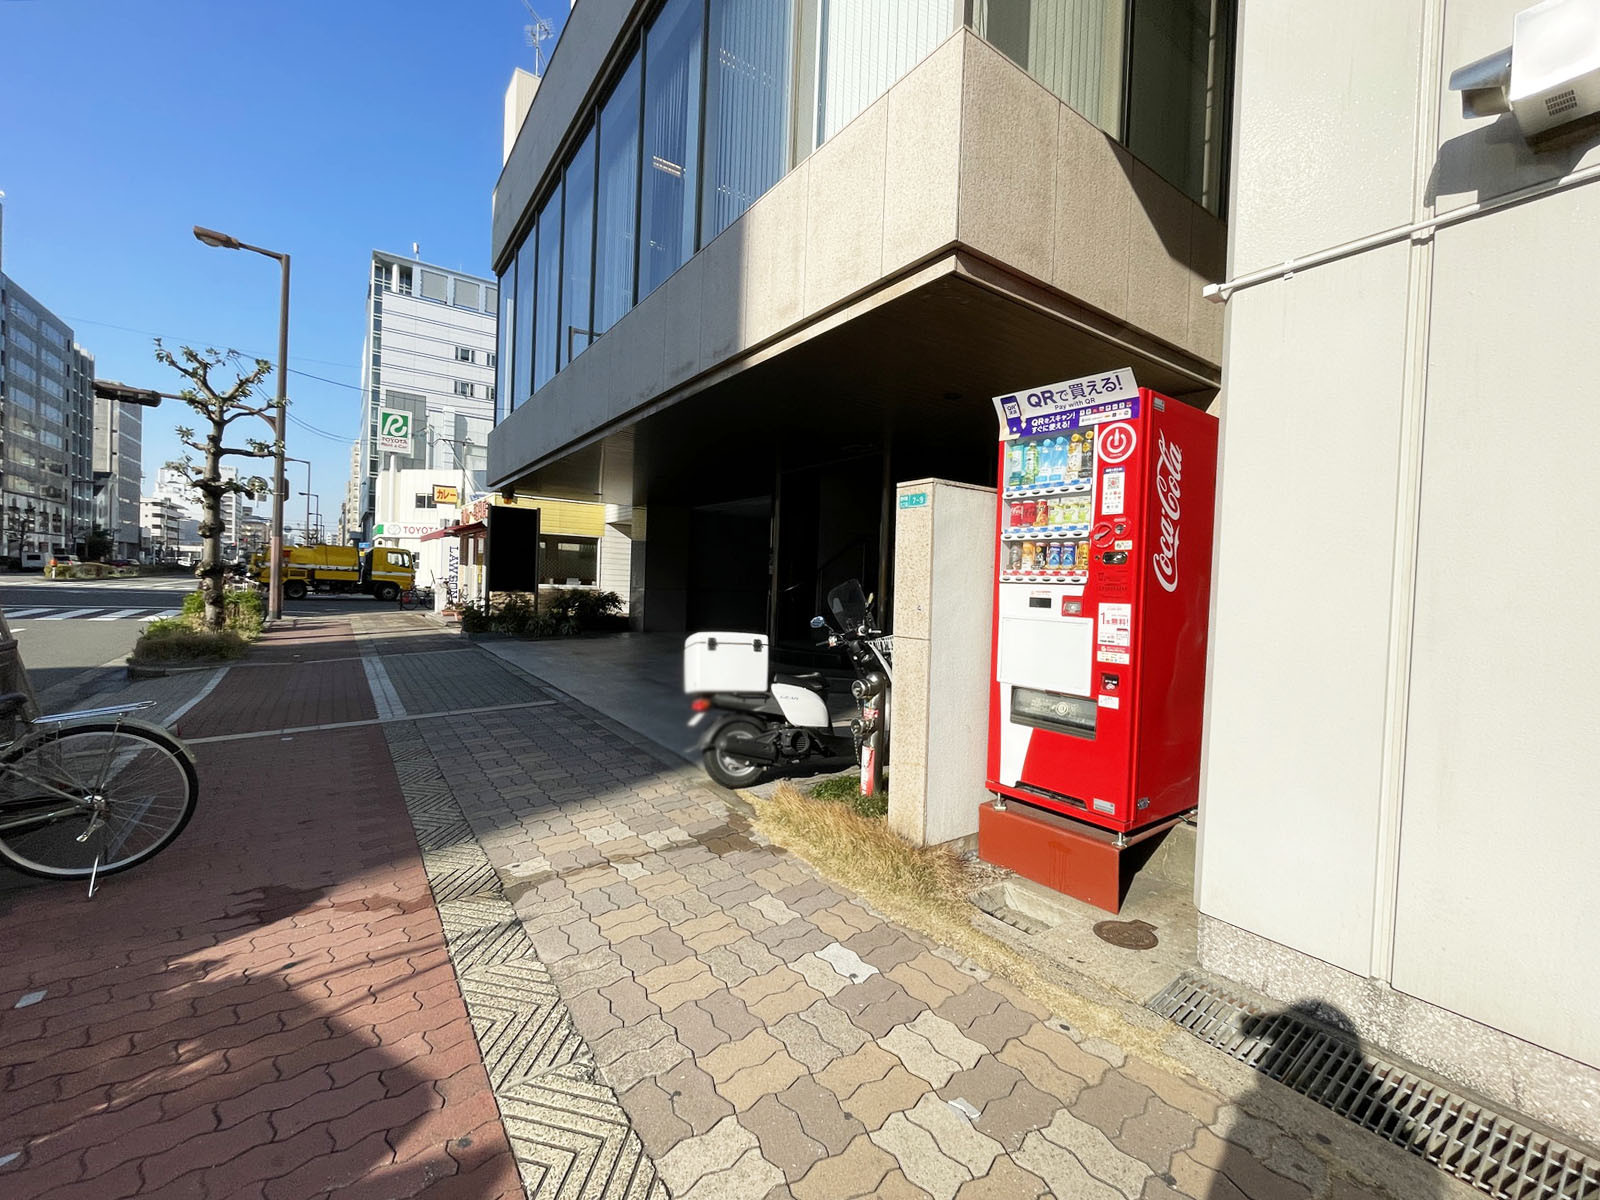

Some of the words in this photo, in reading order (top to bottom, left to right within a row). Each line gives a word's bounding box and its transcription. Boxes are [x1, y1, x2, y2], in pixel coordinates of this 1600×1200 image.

[1027, 375, 1123, 407] QRで買える!
[1054, 404, 1067, 412] Pay
[1068, 399, 1084, 408] with
[1085, 397, 1095, 405] QR
[1031, 411, 1076, 426] QRをスキャン!
[1031, 420, 1070, 434] すぐに使える!
[436, 489, 456, 500] カレー
